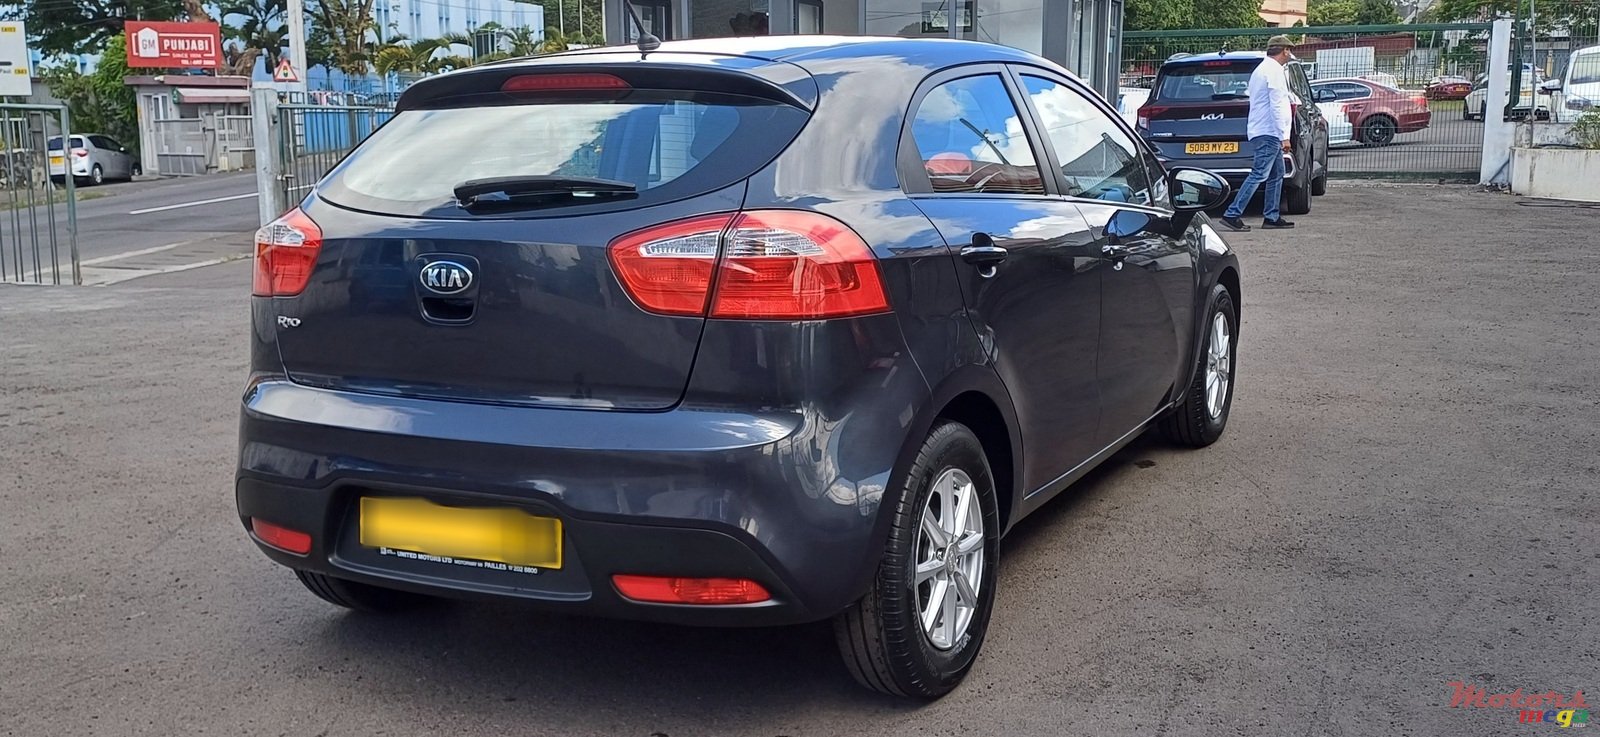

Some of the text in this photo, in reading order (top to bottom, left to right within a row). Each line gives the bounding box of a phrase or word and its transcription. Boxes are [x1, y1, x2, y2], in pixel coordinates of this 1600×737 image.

[142, 39, 156, 50] GM
[163, 39, 209, 51] PUNJABI
[1189, 142, 1235, 152] 5083 MY 23
[427, 268, 463, 288] KIA
[396, 550, 417, 559] UNITED
[418, 553, 441, 562] MOTORS
[442, 556, 453, 564] LTD
[484, 562, 506, 571] PAILLES
